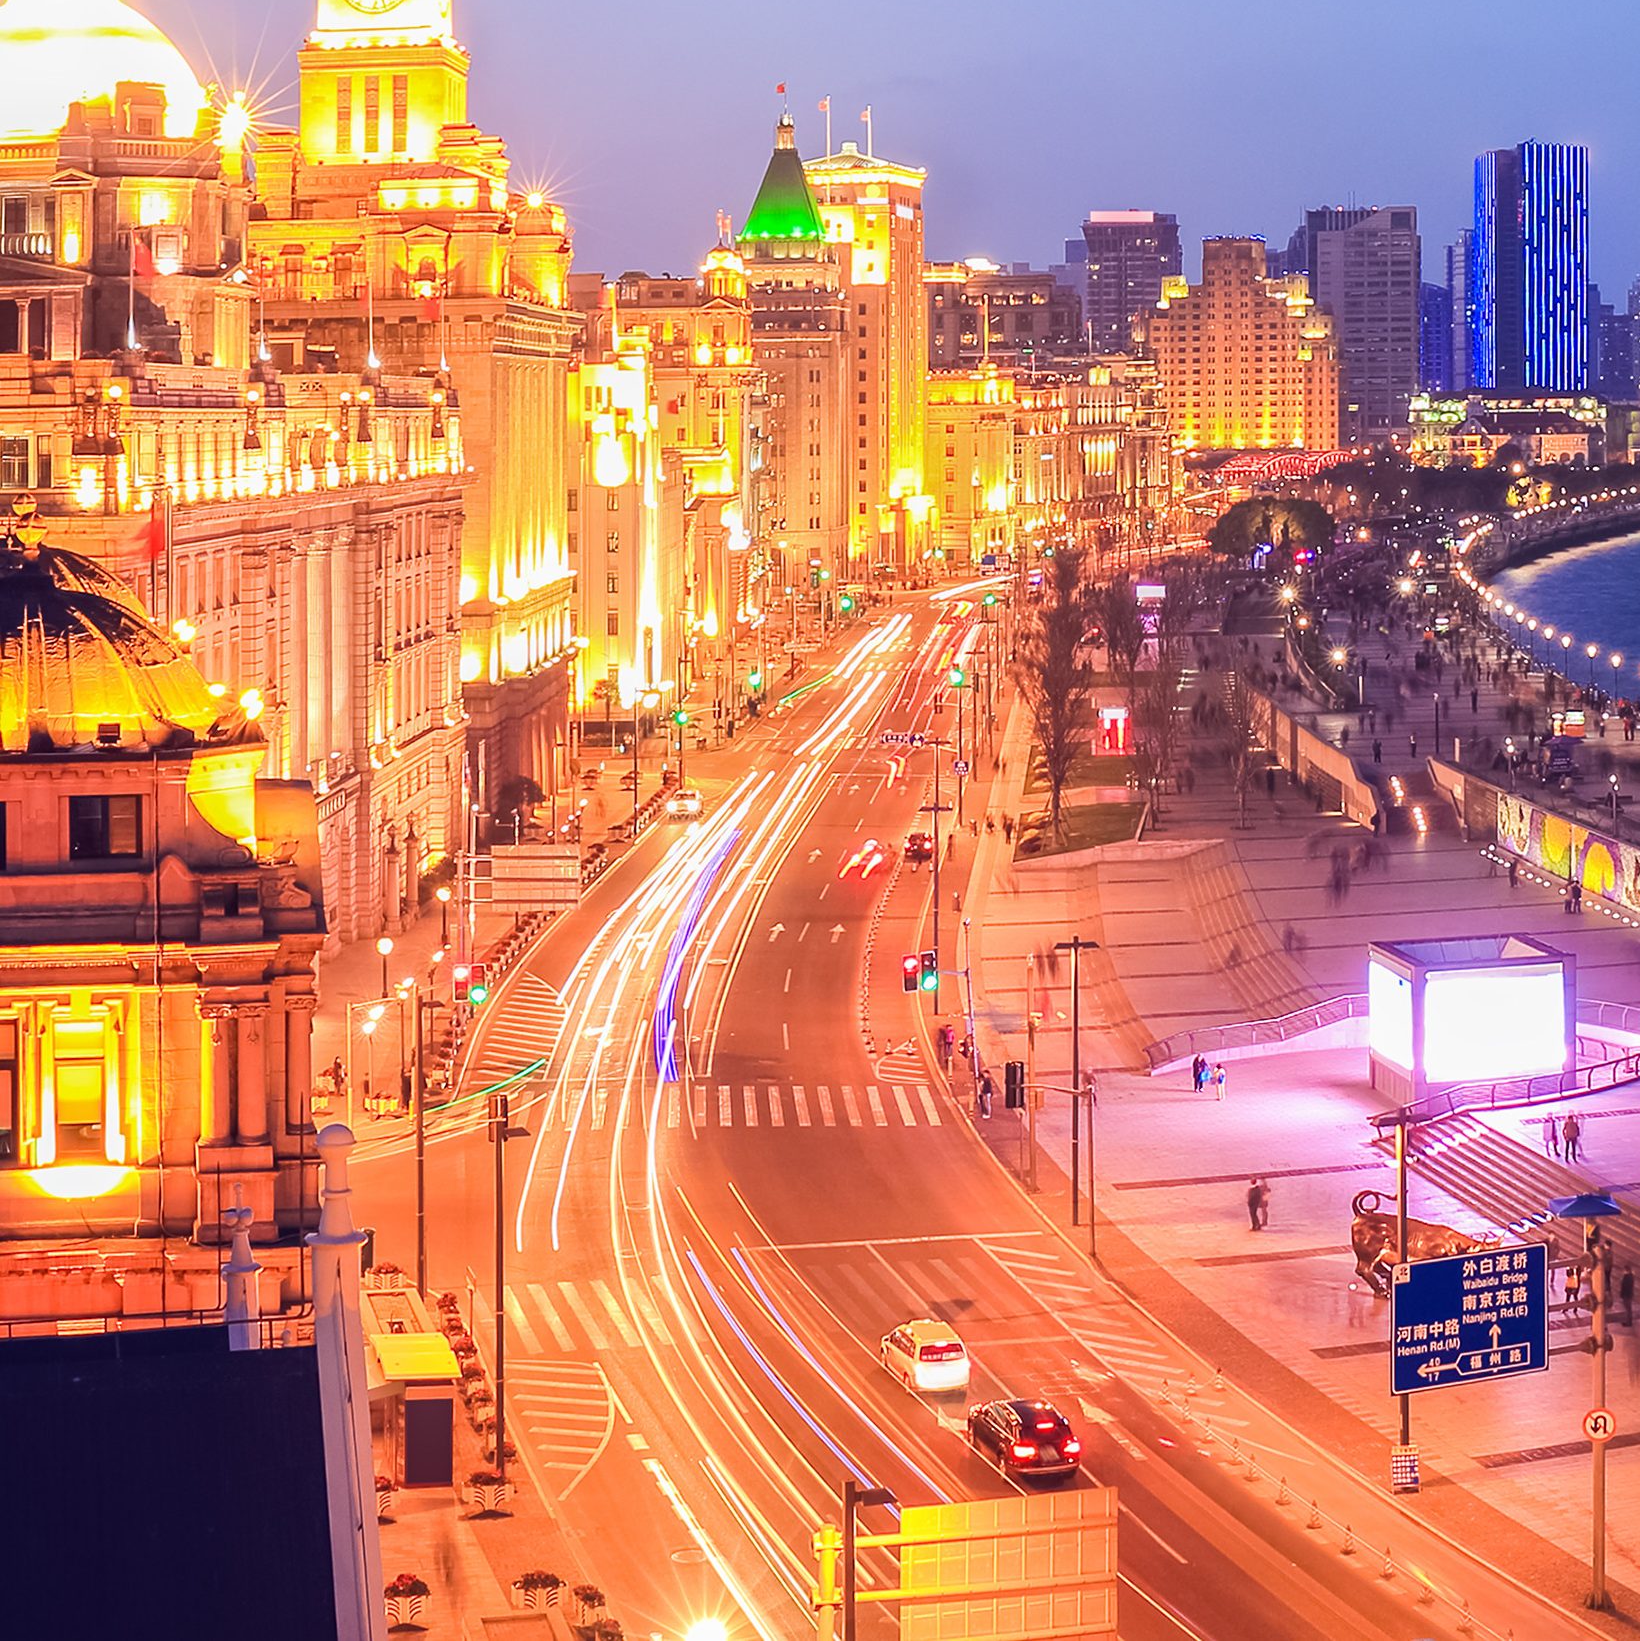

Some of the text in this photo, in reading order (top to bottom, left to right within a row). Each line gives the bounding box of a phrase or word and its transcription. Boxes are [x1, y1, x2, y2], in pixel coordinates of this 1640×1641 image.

[1462, 1252, 1527, 1277] 外白渡桥
[1463, 1272, 1528, 1290] Waibaidu Bridge
[1462, 1286, 1528, 1311] 南京东路
[1462, 1305, 1528, 1324] Nanjing Rd.(E)
[1397, 1318, 1460, 1343] 河南中路
[1397, 1337, 1461, 1357] Henan Rd.(M)
[1428, 1357, 1441, 1366] 40
[1470, 1349, 1521, 1369] 福州路
[1428, 1372, 1440, 1382] 17
